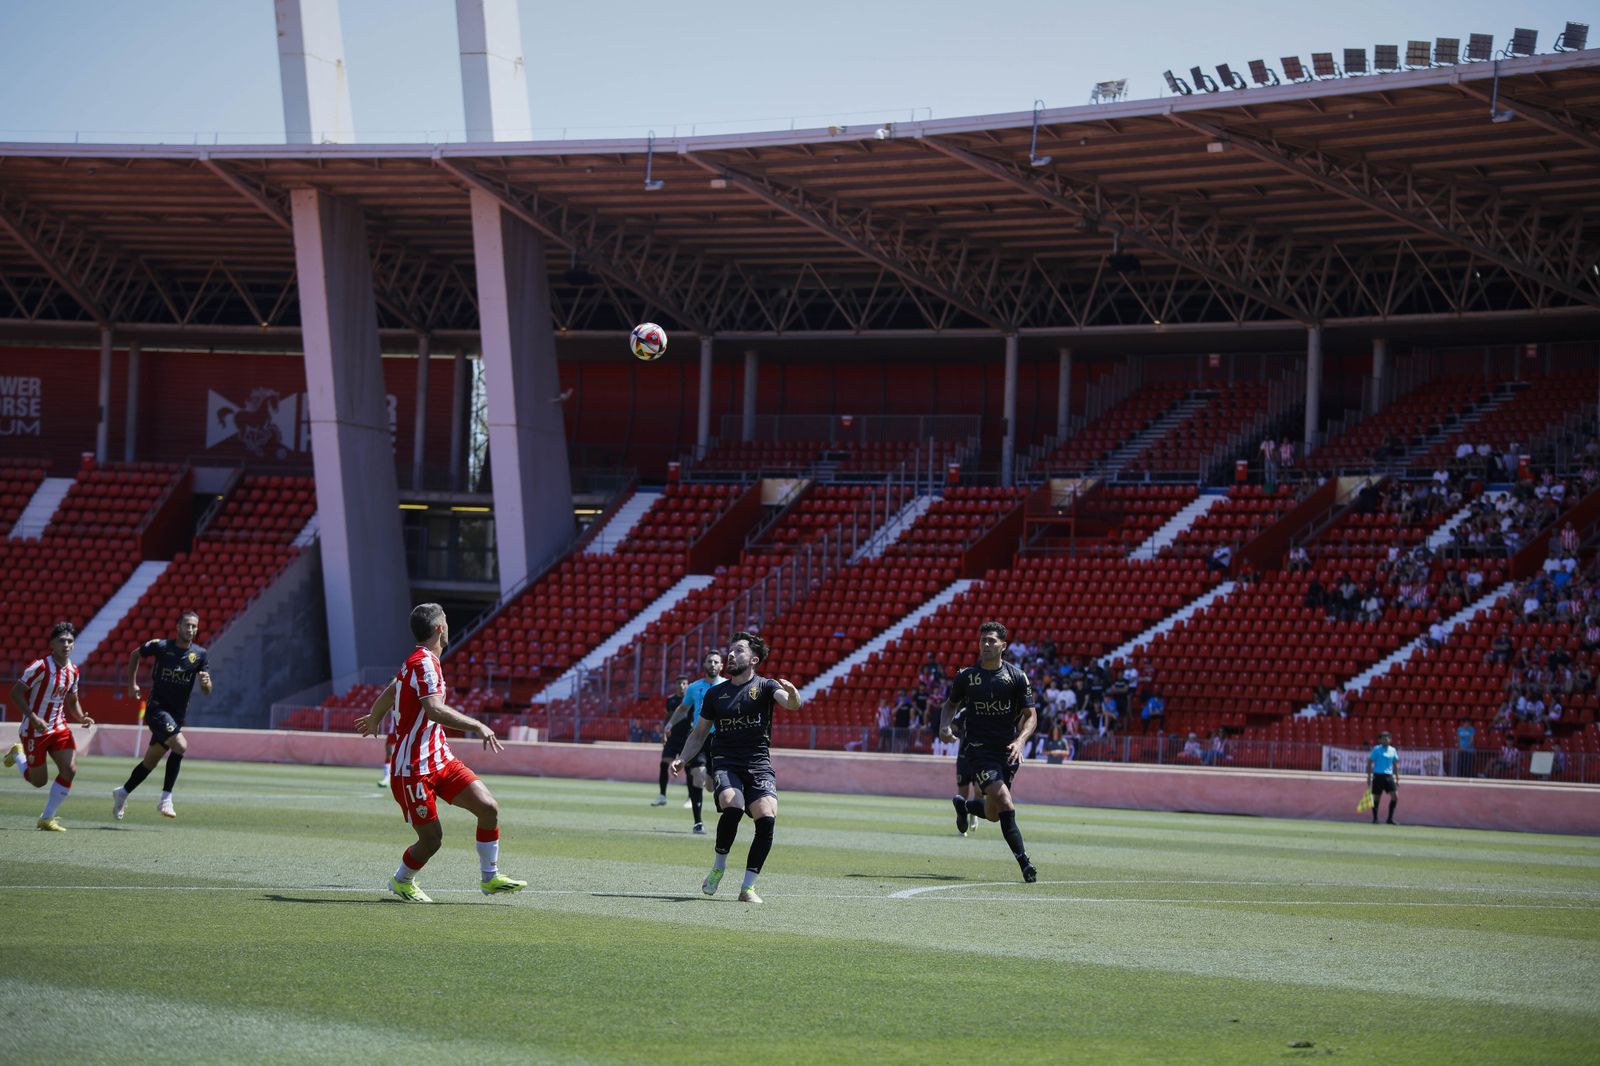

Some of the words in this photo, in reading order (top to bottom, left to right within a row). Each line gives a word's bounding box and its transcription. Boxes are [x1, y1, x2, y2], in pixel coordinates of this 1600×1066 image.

[0, 396, 41, 416] RSE
[161, 667, 193, 682] PKW
[967, 672, 982, 686] 16
[974, 699, 1011, 711] PKW
[720, 713, 761, 726] PKW
[28, 739, 35, 752] 8
[976, 770, 990, 785] 16
[406, 782, 427, 803] 14
